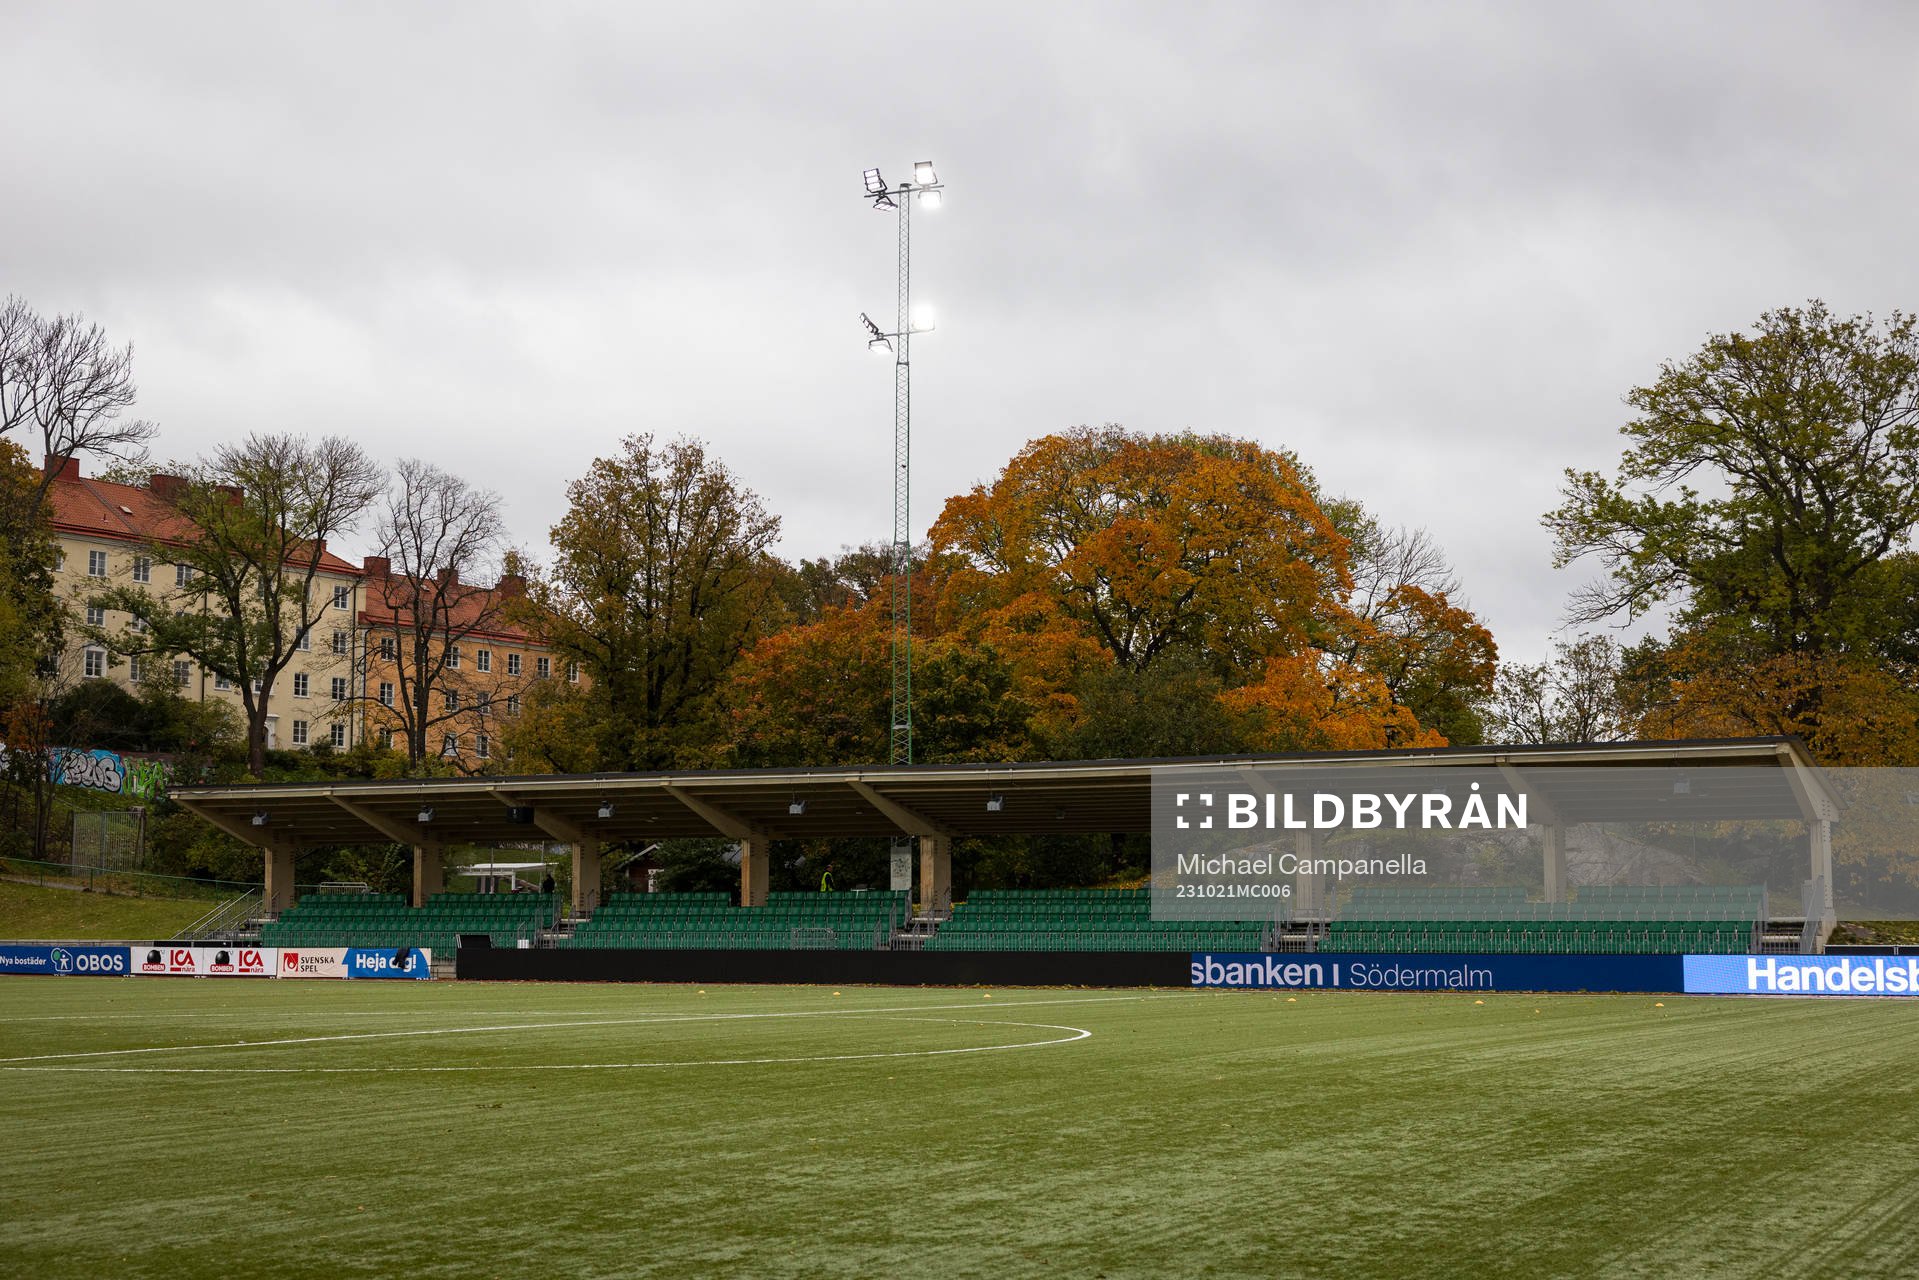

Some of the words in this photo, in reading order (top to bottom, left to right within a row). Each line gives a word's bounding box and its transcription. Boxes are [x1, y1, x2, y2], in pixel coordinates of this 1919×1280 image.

[0, 955, 13, 967] Nya
[14, 956, 47, 966] bostäder
[76, 954, 124, 972] OBOS
[169, 949, 195, 966] ICA
[238, 950, 264, 967] ICA
[300, 956, 335, 965] SVENSKA
[355, 953, 386, 972] Heja
[300, 964, 318, 973] SPEL
[1192, 955, 1323, 986] sbanken
[1350, 962, 1493, 988] Södermalm
